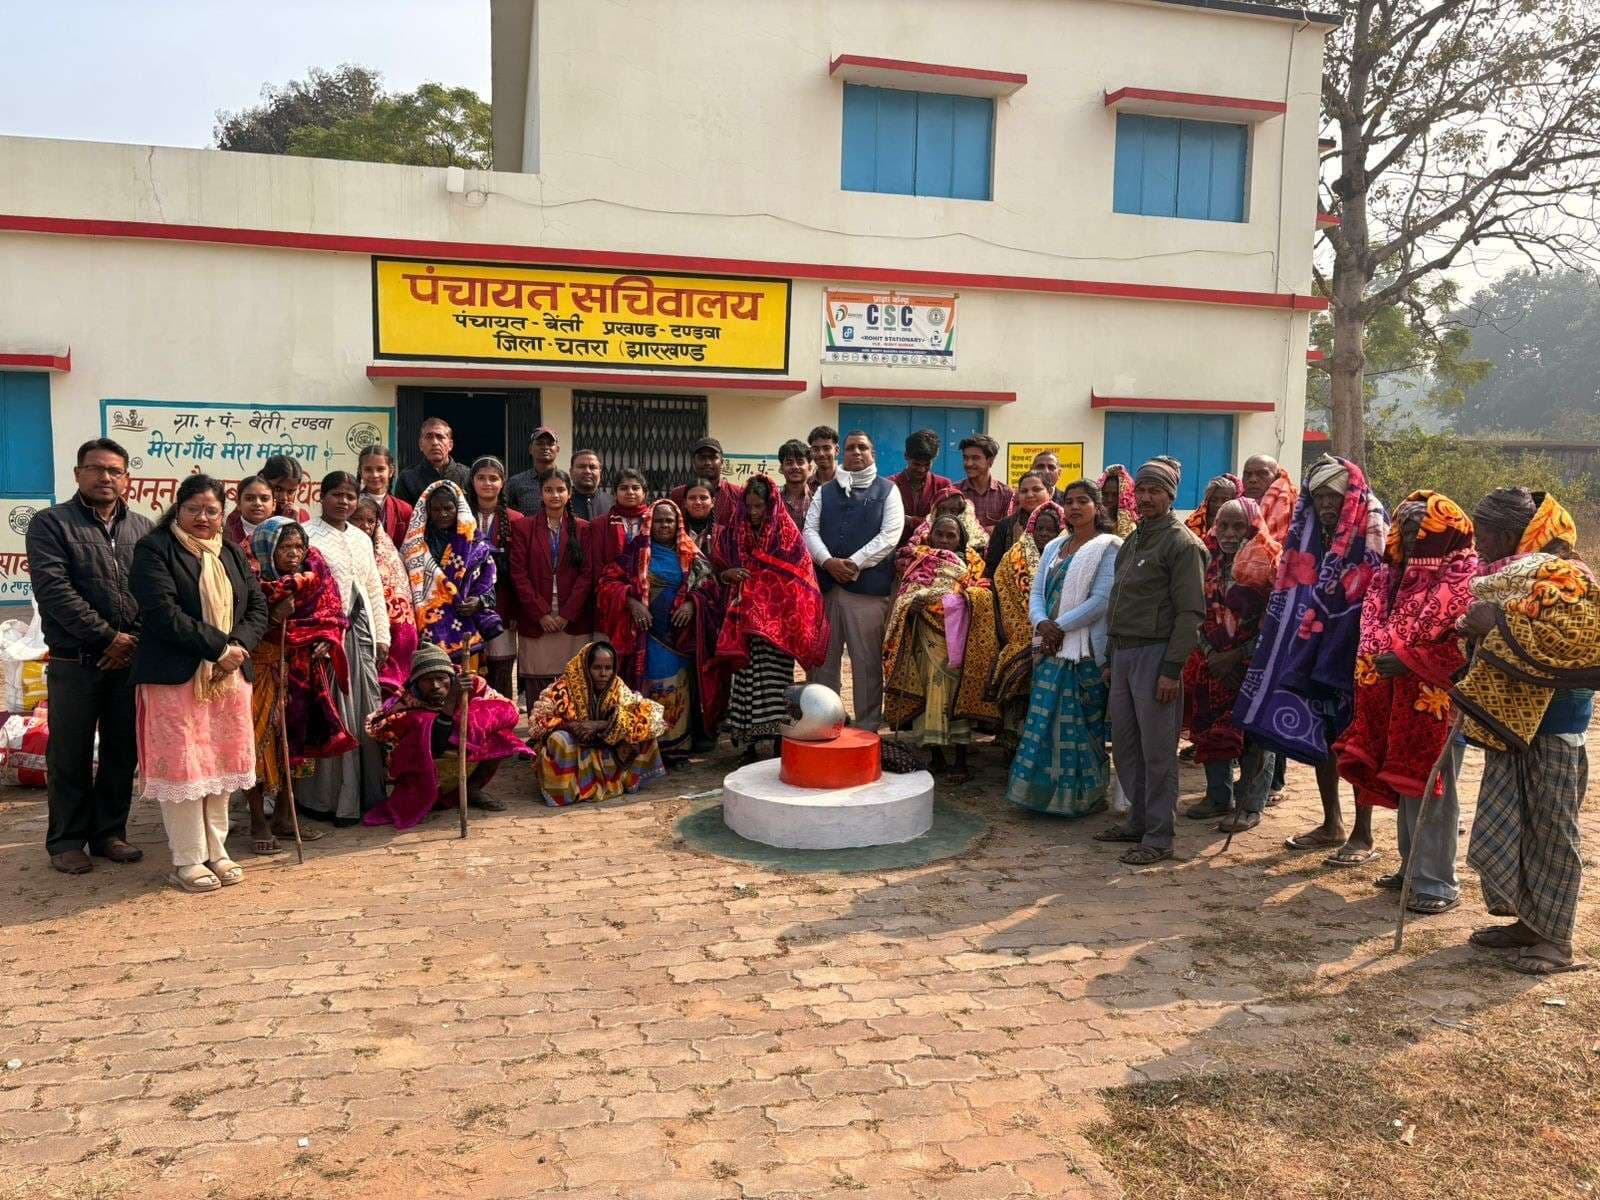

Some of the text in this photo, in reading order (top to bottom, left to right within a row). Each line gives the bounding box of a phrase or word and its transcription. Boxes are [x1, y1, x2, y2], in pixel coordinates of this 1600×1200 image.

[402, 265, 765, 321] पंचायत सचिवालय
[452, 310, 529, 331] पंचायत
[669, 324, 721, 340] टण्डवा
[866, 304, 913, 327] CSC
[492, 330, 546, 353] जिला
[554, 336, 609, 356] चतरा
[173, 414, 200, 435] ग्रा.
[291, 417, 334, 431] टण्डवा
[147, 430, 184, 467] मेरा
[182, 434, 218, 459] गाँव
[220, 431, 254, 472] मेरा
